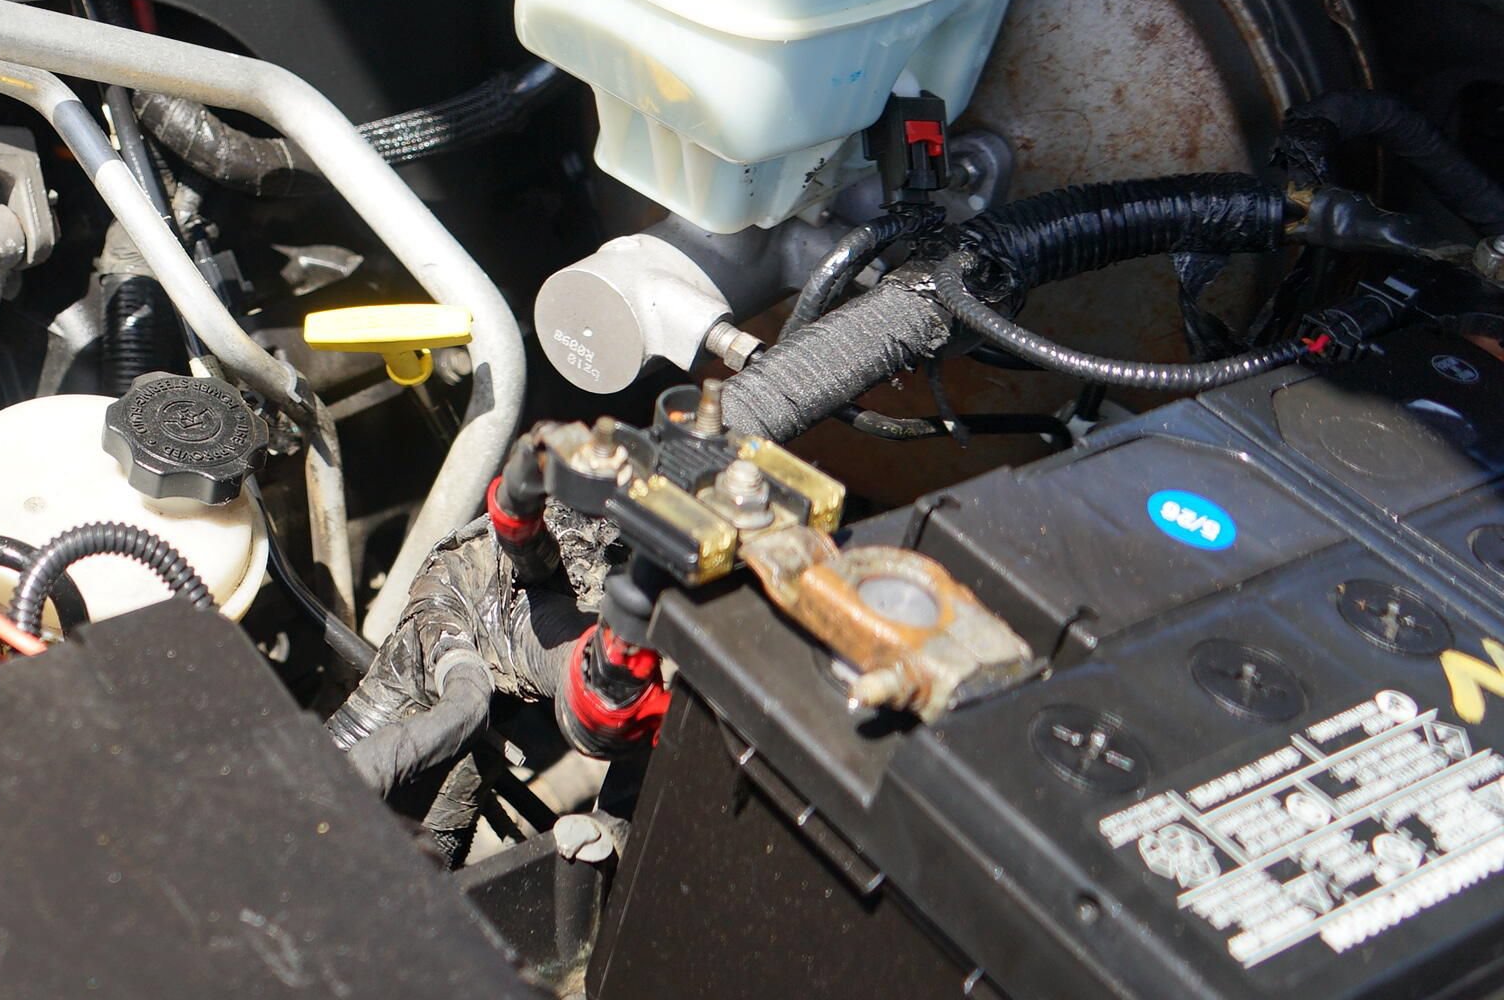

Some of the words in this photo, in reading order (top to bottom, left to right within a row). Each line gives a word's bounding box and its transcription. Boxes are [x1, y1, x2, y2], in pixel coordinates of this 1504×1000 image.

[135, 377, 189, 406] STEERING
[192, 380, 240, 411] POWER
[231, 423, 250, 446] USE
[162, 443, 237, 464] APPROVED
